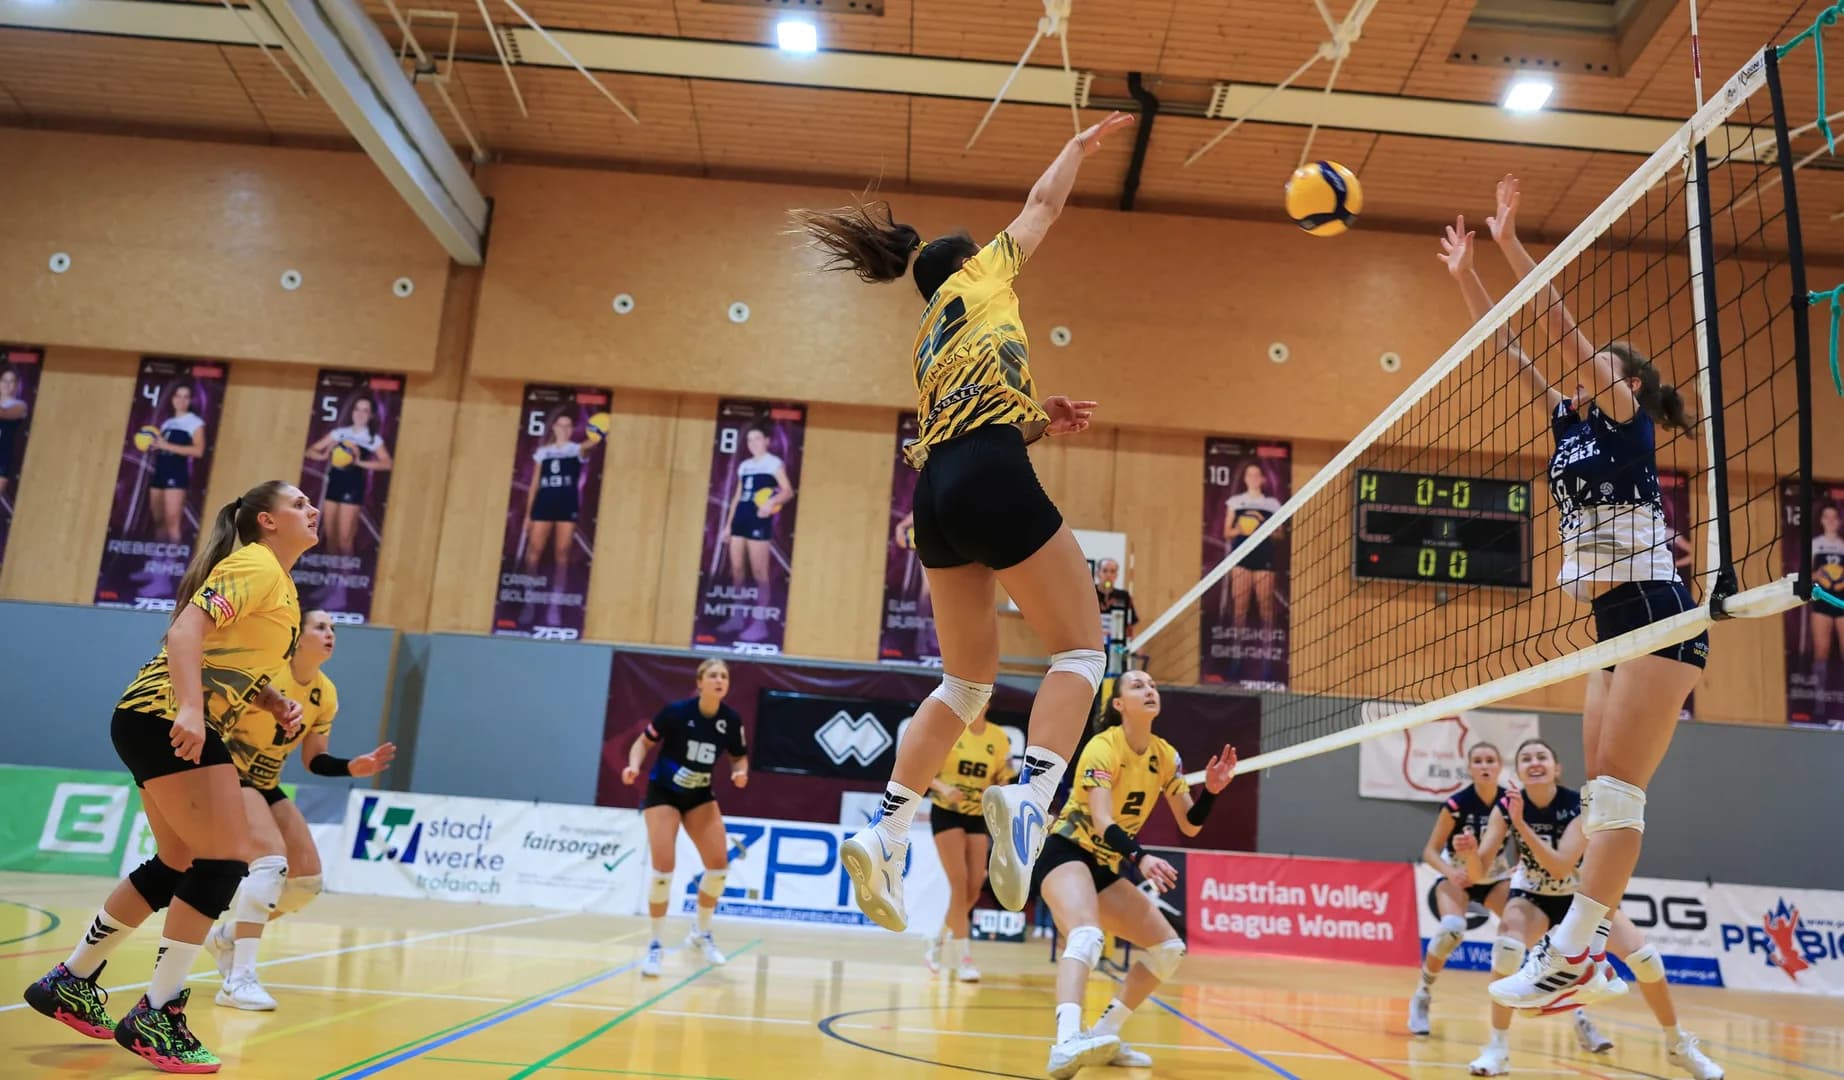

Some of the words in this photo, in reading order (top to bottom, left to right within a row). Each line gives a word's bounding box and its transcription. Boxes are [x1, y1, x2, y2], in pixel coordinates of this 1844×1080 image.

[143, 384, 160, 407] 4
[321, 396, 338, 421] 5
[528, 411, 545, 436] 6
[720, 428, 738, 453] 8
[1208, 465, 1230, 486] 10
[1360, 474, 1377, 501] H
[1416, 478, 1470, 509] 0-0
[108, 540, 190, 558] REBECCA
[300, 554, 361, 569] HERESA
[1418, 548, 1436, 577] 0
[1449, 550, 1468, 578] 0
[706, 585, 758, 600] JULIA
[704, 603, 781, 621] MITTER
[686, 740, 716, 764] 16
[958, 760, 988, 778] 66
[1121, 791, 1146, 816] 2
[427, 814, 493, 841] stadt
[424, 844, 505, 871] werke
[522, 831, 621, 860] fairsorger
[1201, 878, 1306, 906] Austrian
[1310, 883, 1389, 915] Volley
[1201, 908, 1292, 940] League
[1297, 914, 1394, 941] Women
